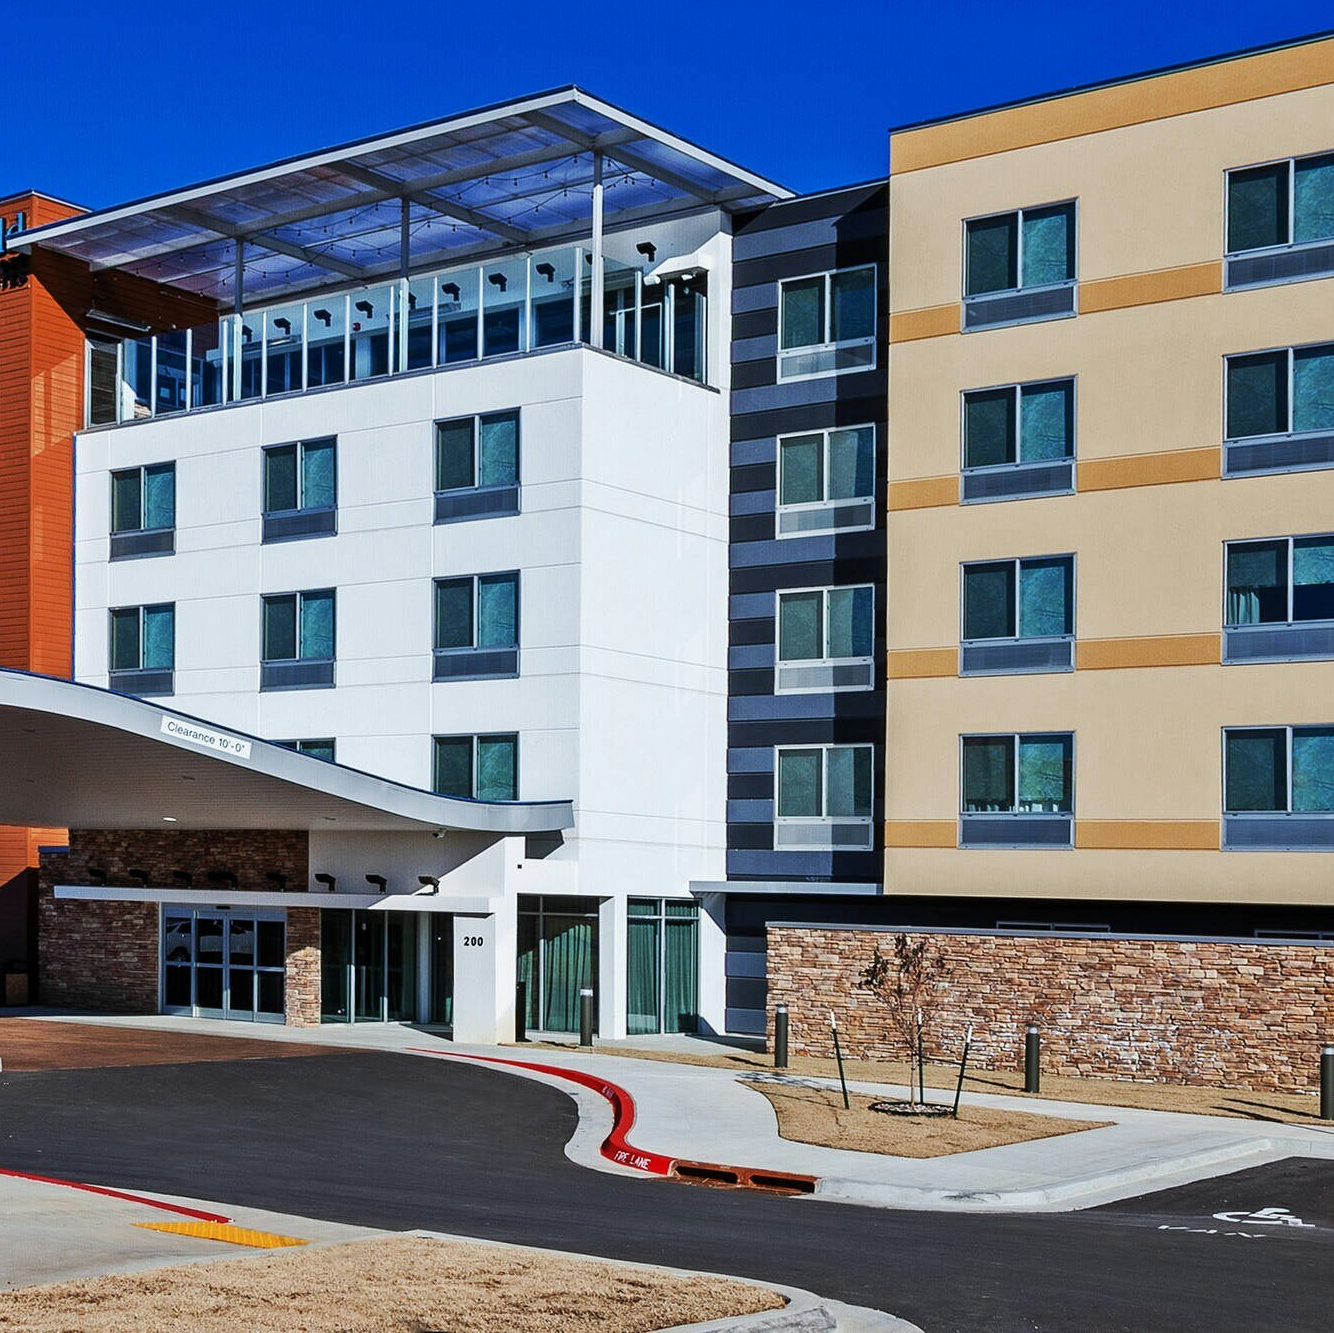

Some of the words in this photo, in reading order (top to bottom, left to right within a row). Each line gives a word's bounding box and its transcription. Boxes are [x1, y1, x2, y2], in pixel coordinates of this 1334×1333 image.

[167, 721, 216, 745] Clearance
[463, 936, 484, 947] 200
[629, 1154, 652, 1170] LANE
